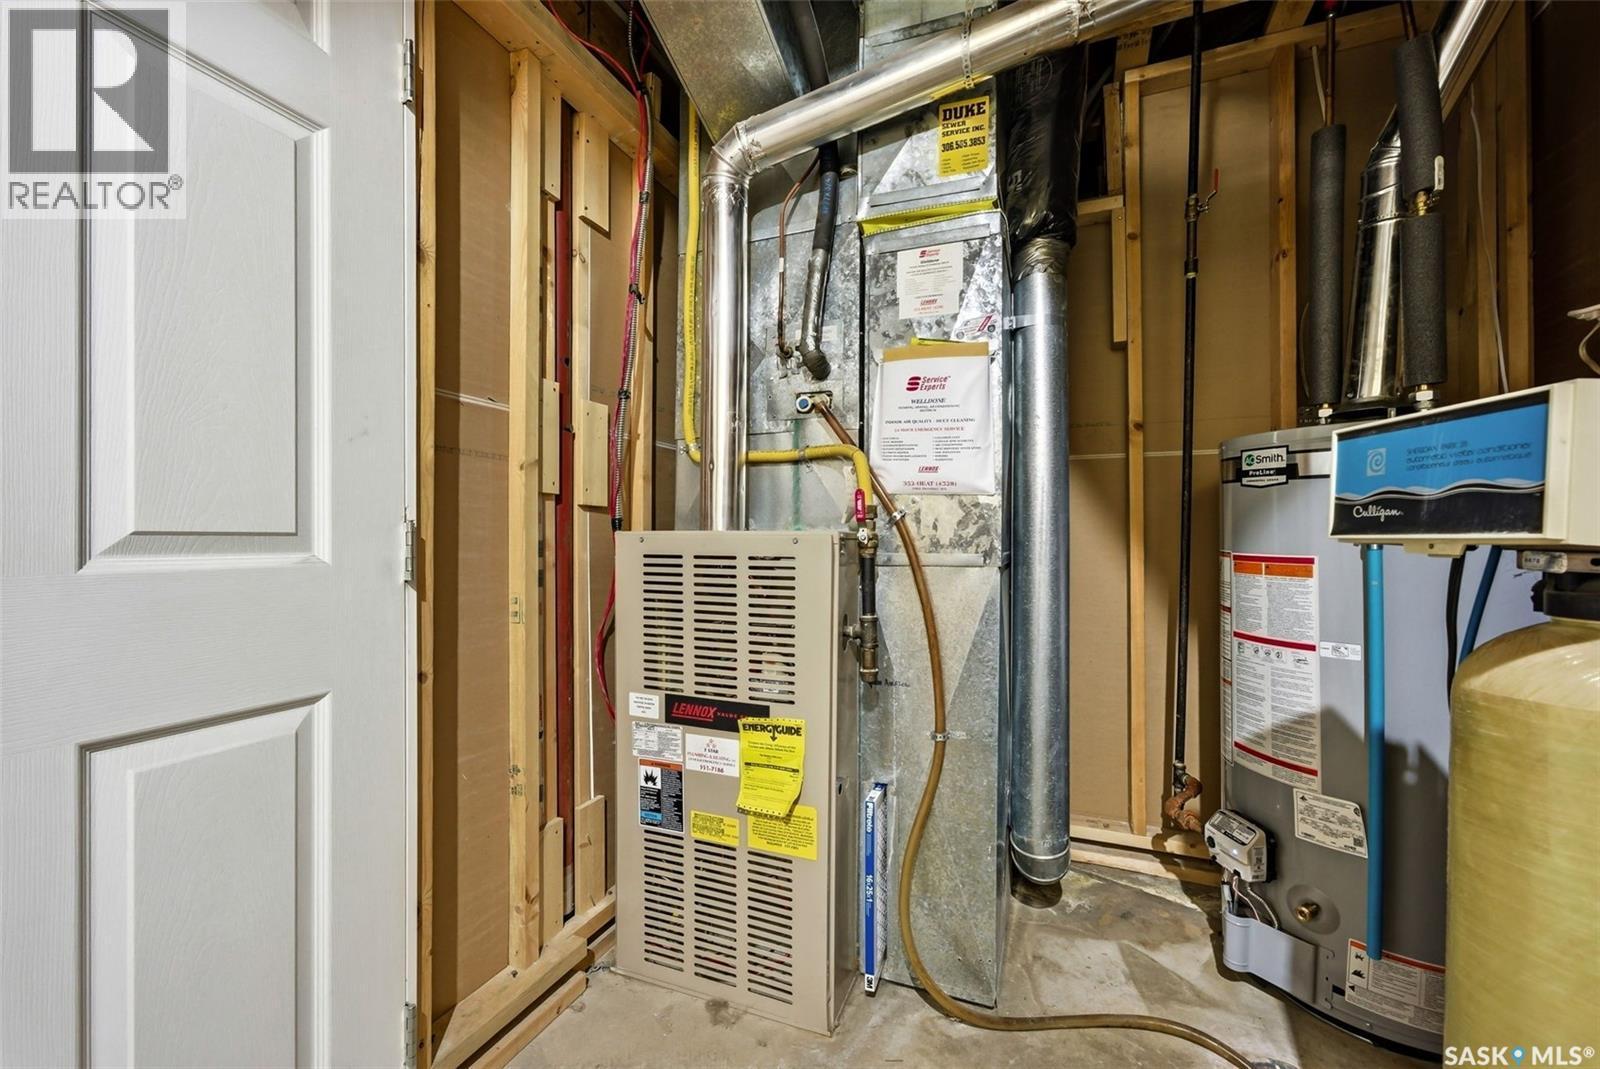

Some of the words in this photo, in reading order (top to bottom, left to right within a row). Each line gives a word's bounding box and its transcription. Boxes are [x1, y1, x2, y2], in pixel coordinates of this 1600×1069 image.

[942, 101, 986, 121] DUKE
[942, 120, 966, 129] SEWER
[941, 127, 970, 137] SERVICE
[921, 376, 948, 384] Service
[920, 383, 946, 391] Experts
[1353, 505, 1402, 522] Culligan
[672, 702, 717, 718] LENNOX
